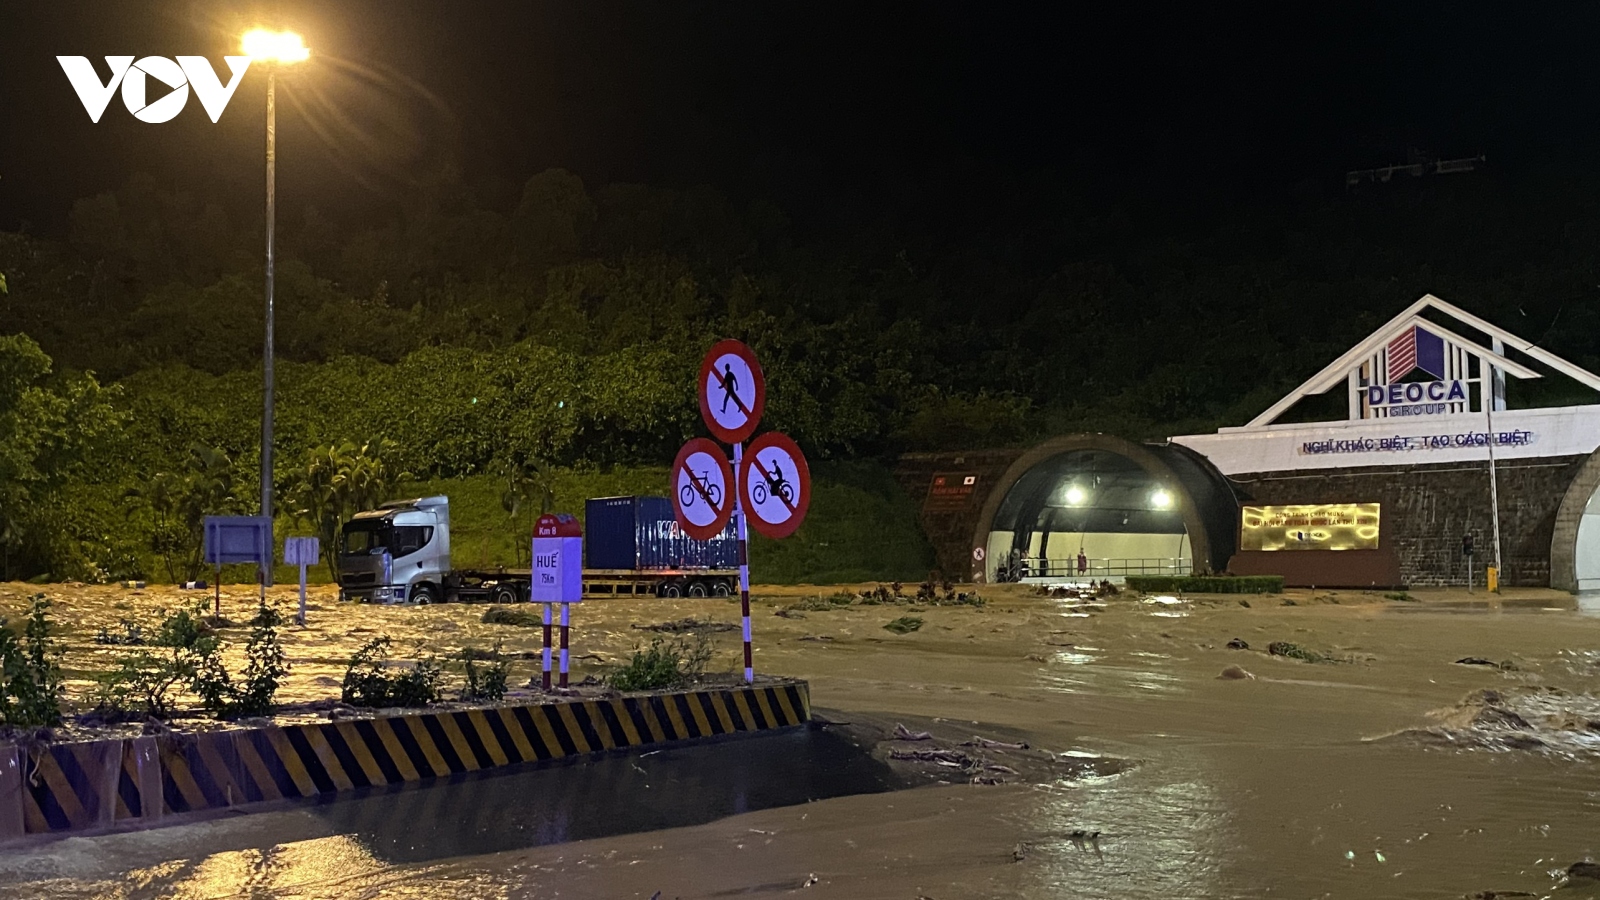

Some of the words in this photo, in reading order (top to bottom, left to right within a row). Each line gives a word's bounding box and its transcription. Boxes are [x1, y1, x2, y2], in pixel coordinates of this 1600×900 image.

[1368, 380, 1465, 405] DEOCA
[1389, 403, 1446, 416] GROUP
[1335, 437, 1374, 452] KHÁC
[1455, 431, 1495, 446] CÁCH
[1499, 429, 1531, 446] BIỆT
[538, 526, 550, 535] Km
[551, 526, 557, 535] 8
[536, 551, 559, 568] HUẾ
